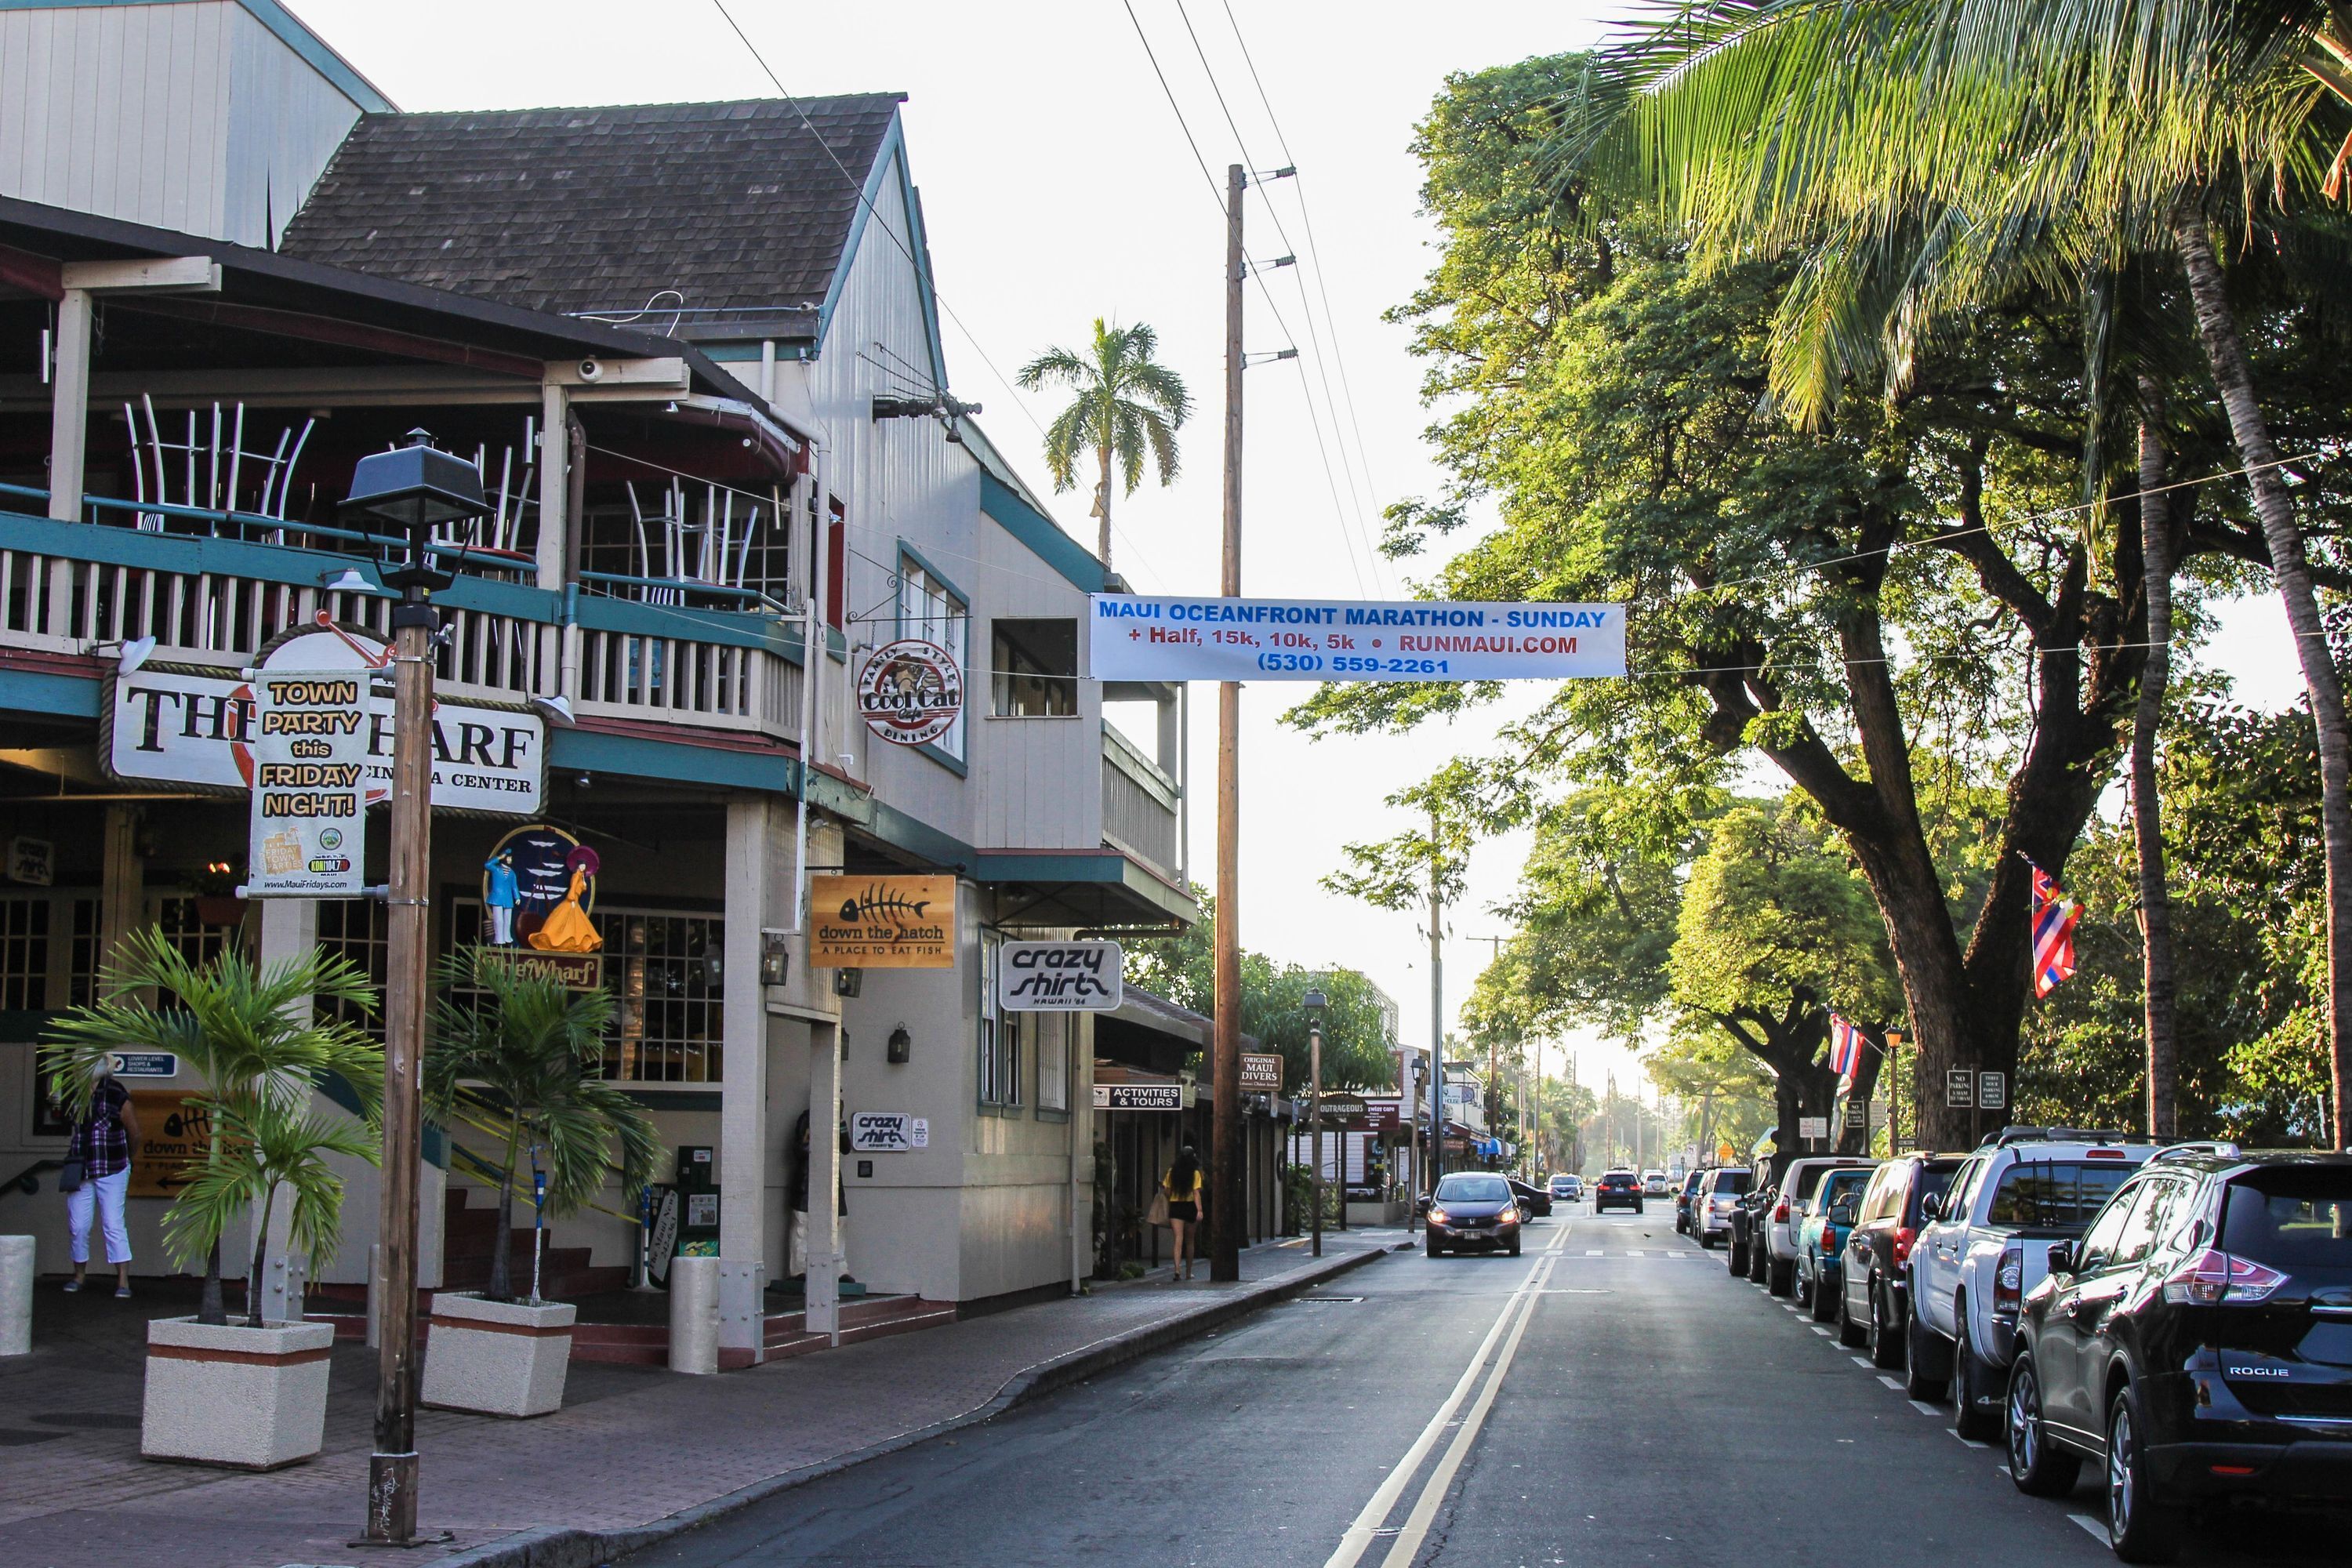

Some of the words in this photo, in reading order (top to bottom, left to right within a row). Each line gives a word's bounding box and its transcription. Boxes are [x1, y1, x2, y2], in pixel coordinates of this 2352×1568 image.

[1099, 601, 1160, 619] MAUI
[1169, 604, 1338, 625] OCEANFRONT
[1345, 608, 1483, 626] MARATHON
[1507, 611, 1606, 628] SUNDAY
[1129, 629, 1141, 641] +
[1149, 626, 1203, 647] Half,
[1212, 630, 1260, 648] 15k,
[1269, 632, 1318, 651] 10k,
[1327, 633, 1355, 650] 5k
[1399, 635, 1577, 654] RUNMAUI.COM
[923, 647, 956, 682] STYLE
[1258, 653, 1323, 672] (530)
[1333, 656, 1448, 673] 559-2261
[269, 682, 357, 704] TOWN
[864, 691, 912, 710] Cool
[917, 688, 958, 709] Cat
[263, 711, 361, 733] PARTY
[884, 725, 938, 742] DINING
[292, 740, 331, 757] this
[260, 764, 361, 786] FRIDAY
[452, 774, 532, 793] CENTER
[263, 793, 355, 817] NIGHT!
[265, 846, 297, 855] FRIDAY
[267, 854, 295, 863] TOWN
[267, 859, 303, 870] PARTIES
[264, 880, 347, 890] www.MauiFridays.com
[819, 925, 862, 939] down
[868, 926, 893, 939] the
[899, 925, 944, 939] hatch
[822, 946, 829, 955] A
[835, 946, 866, 955] PLACE
[873, 946, 885, 955] TO
[1012, 949, 1105, 974] crazy
[526, 958, 594, 985] Wharf
[1010, 972, 1109, 996] shirts
[1241, 1072, 1277, 1080] DIVERS
[1247, 1064, 1273, 1073] MAUI
[1113, 1088, 1178, 1097] ACTIVITIES
[1131, 1098, 1174, 1106] TOURS
[1320, 1104, 1363, 1112] OUTRAGEOUS
[859, 1116, 903, 1131] crazy
[858, 1129, 906, 1143] shirts
[143, 1140, 187, 1154] down
[655, 1221, 667, 1249] Maui
[664, 1192, 677, 1220] News
[2230, 1367, 2289, 1377] ROGUE
